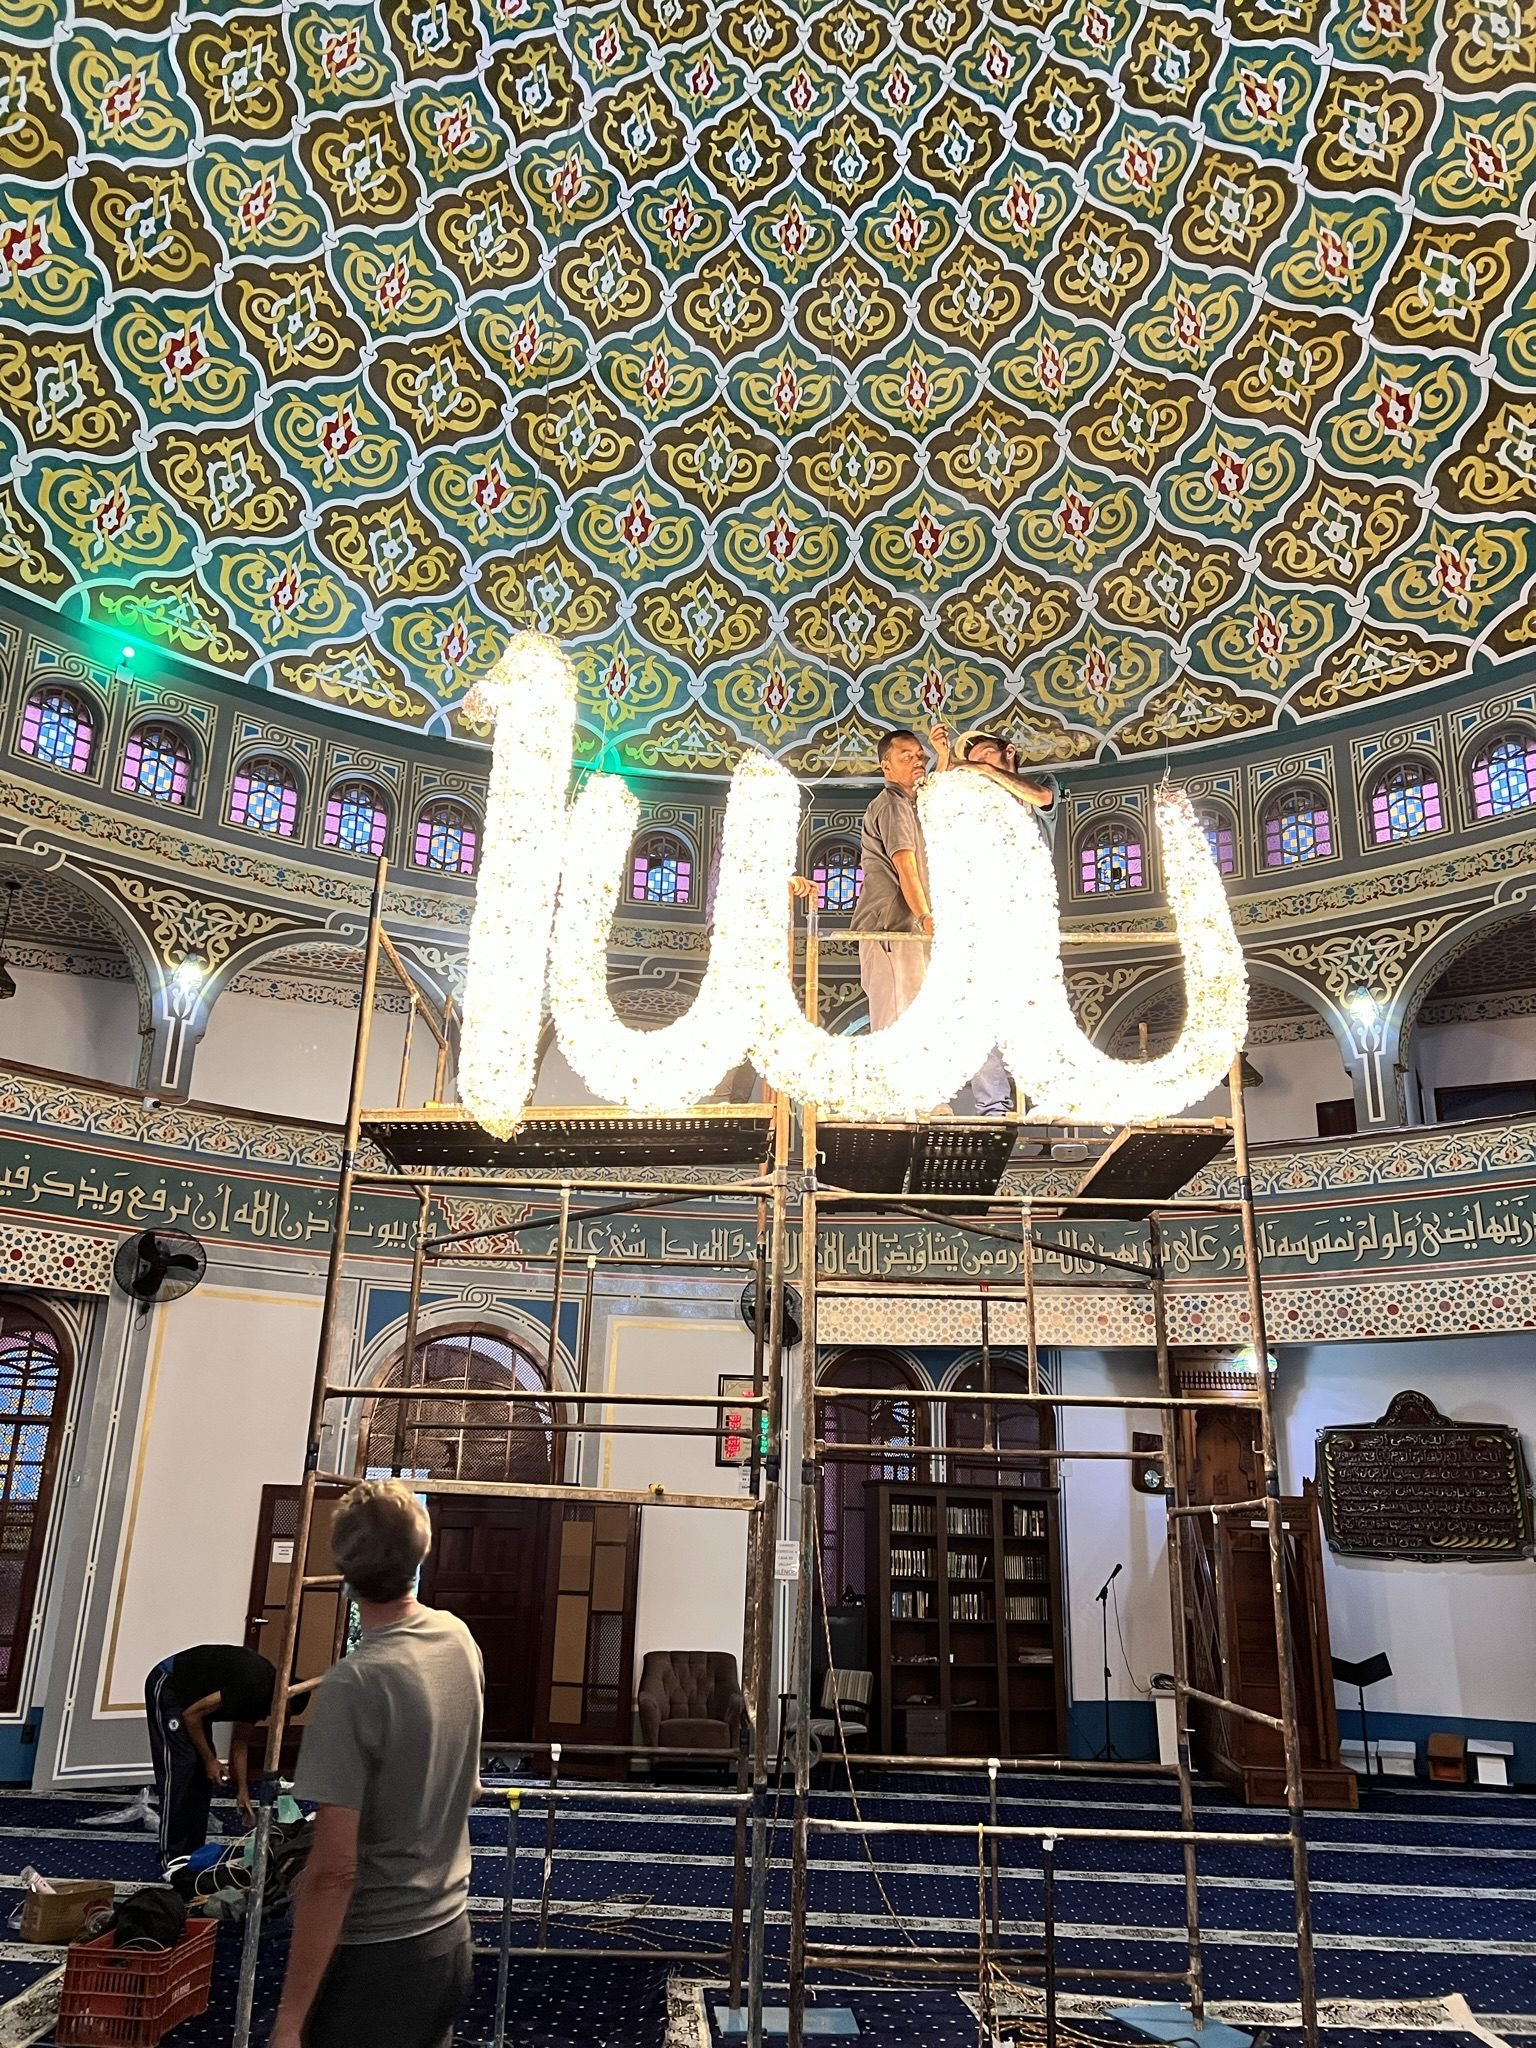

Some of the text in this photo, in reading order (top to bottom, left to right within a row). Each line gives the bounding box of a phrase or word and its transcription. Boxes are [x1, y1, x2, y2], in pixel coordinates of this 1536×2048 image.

[127, 1179, 193, 1224] ترفع
[192, 1183, 232, 1232] أن
[233, 1189, 280, 1238] الله
[279, 1197, 336, 1241] ذن
[846, 1231, 881, 1275] الله
